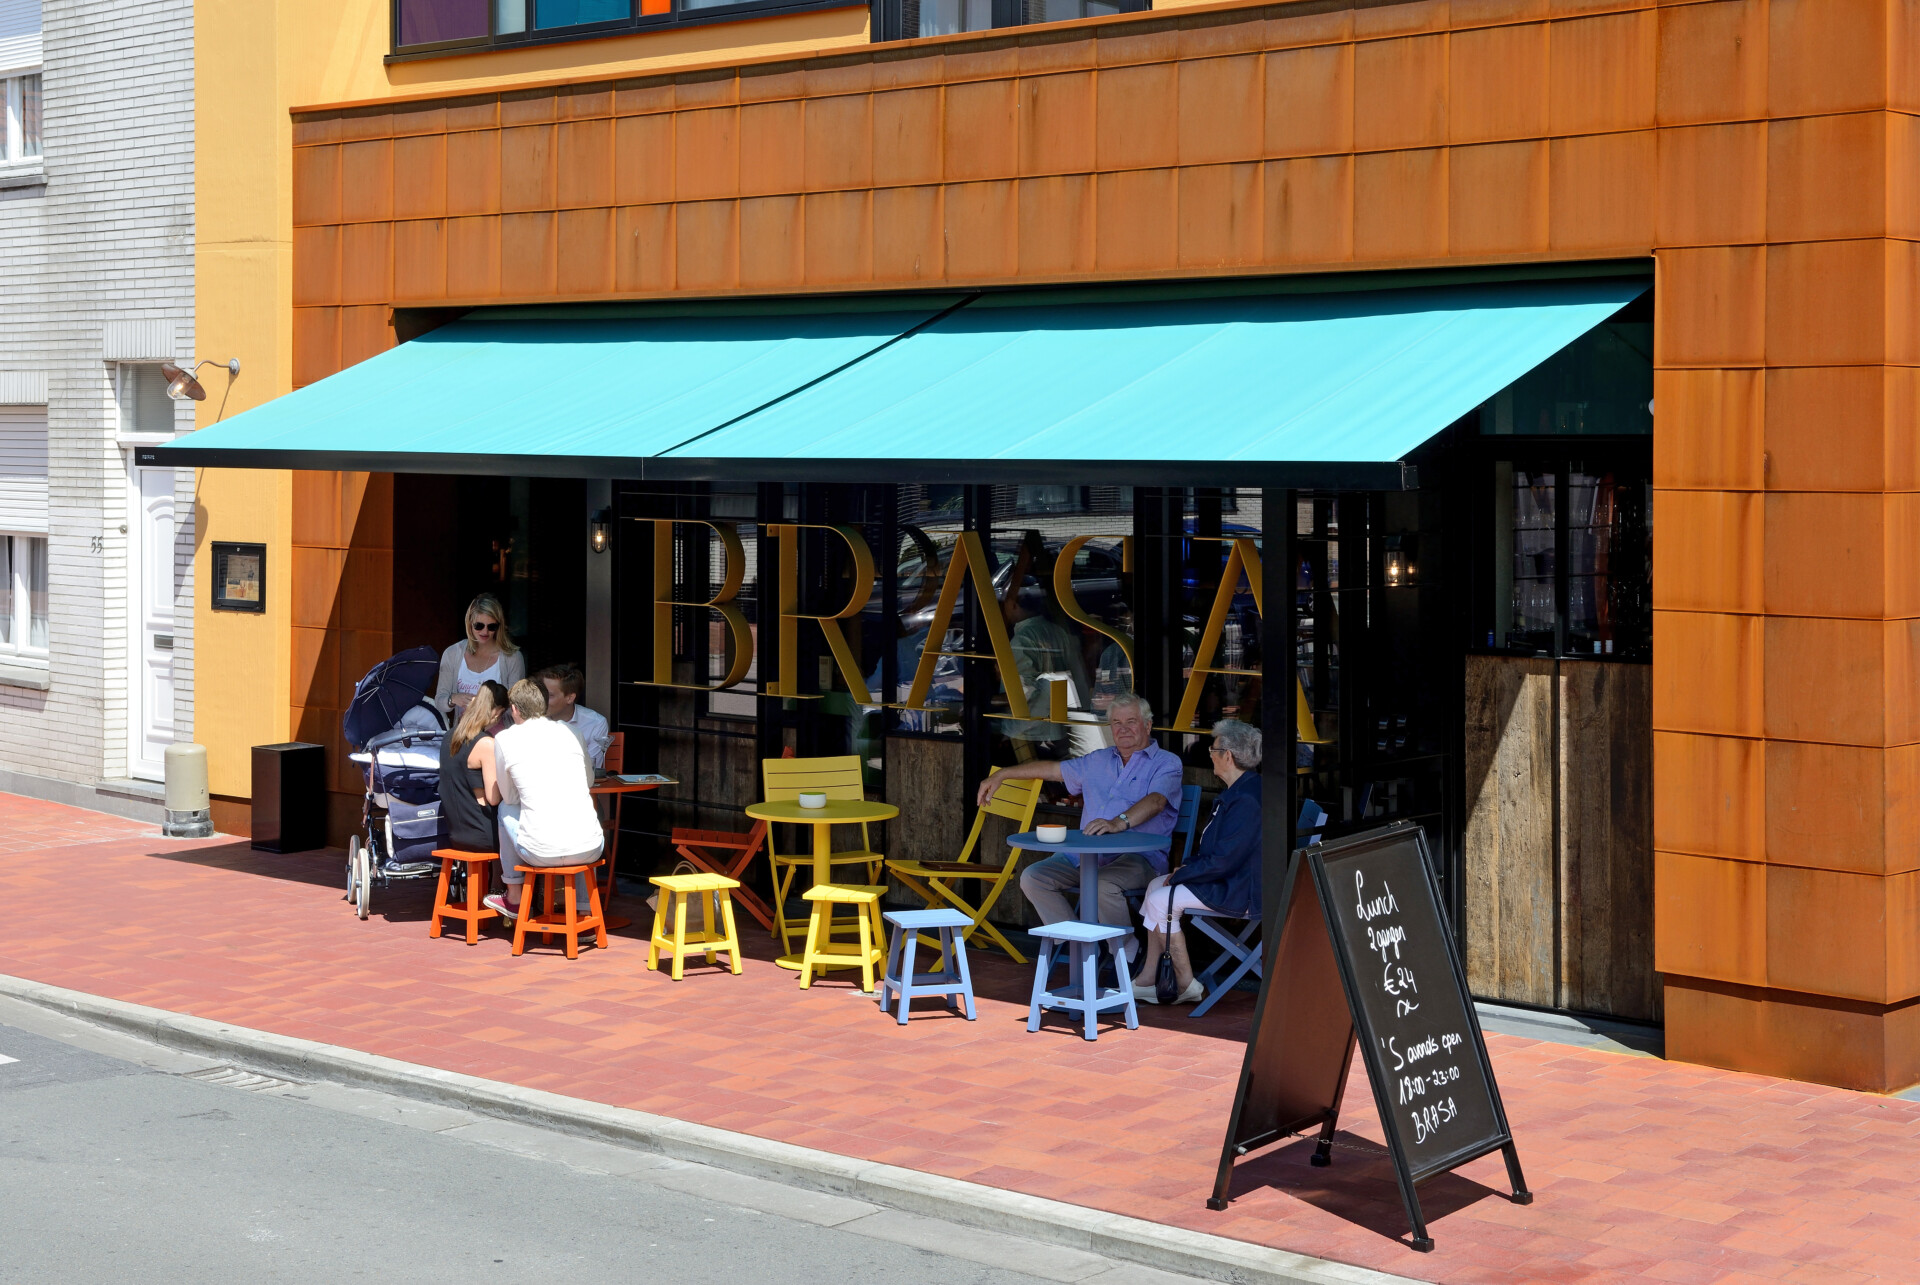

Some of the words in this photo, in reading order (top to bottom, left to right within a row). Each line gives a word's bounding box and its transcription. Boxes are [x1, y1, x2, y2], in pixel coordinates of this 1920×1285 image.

[90, 535, 103, 554] 55
[634, 517, 1332, 744] BRASA
[1356, 870, 1400, 922] Lunch
[1441, 1032, 1462, 1055] open
[1411, 1096, 1458, 1145] BRASA
